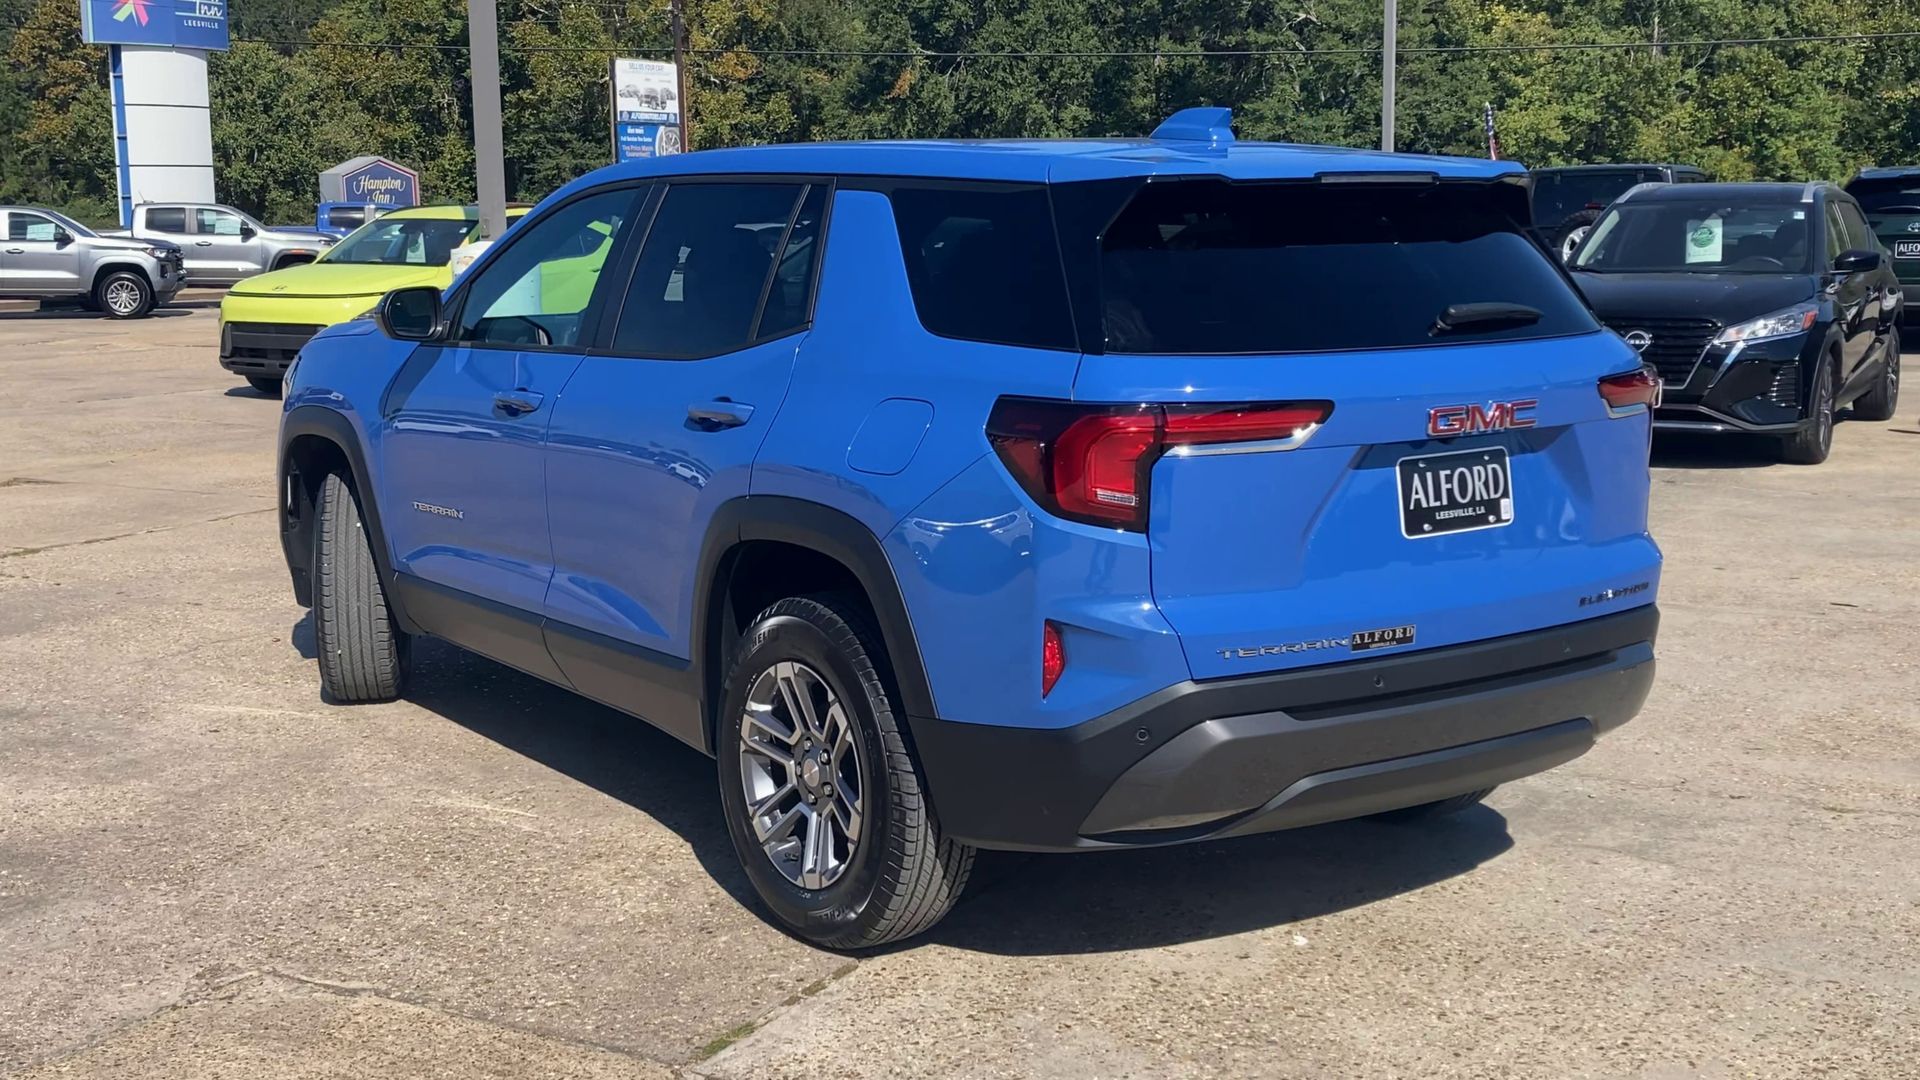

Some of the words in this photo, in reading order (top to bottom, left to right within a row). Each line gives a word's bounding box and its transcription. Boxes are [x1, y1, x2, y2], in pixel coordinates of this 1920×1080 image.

[184, 19, 218, 29] LEESVILLE
[353, 174, 406, 195] Hampton
[367, 190, 396, 204] Inn
[1428, 399, 1538, 437] GMC
[1409, 463, 1505, 510] ALFORD
[411, 501, 464, 519] TERRAIN
[1435, 507, 1476, 520] LEESVILLE,
[1475, 505, 1486, 515] LA
[1352, 625, 1414, 645] ALFORD
[1216, 637, 1350, 659] TERRAIN
